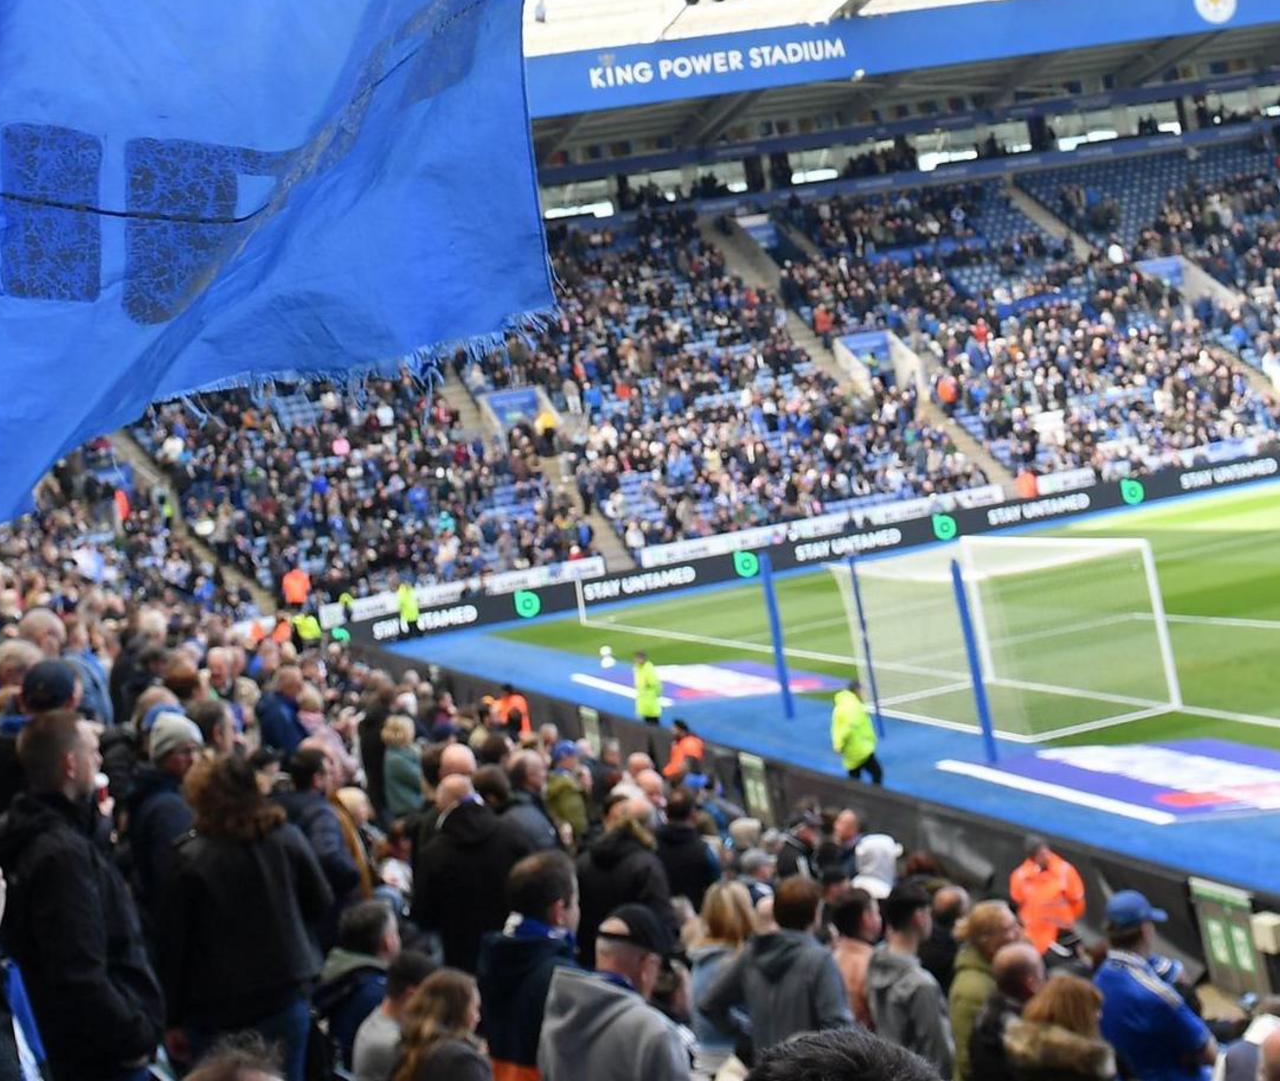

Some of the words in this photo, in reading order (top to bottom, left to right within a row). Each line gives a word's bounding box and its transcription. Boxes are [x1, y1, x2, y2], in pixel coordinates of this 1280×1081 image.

[589, 61, 654, 89] KING
[658, 50, 744, 81] POWER
[748, 38, 846, 69] STADIUM
[1180, 469, 1212, 489] STAY
[1213, 458, 1277, 483] UNTAMED
[987, 504, 1021, 525] STAY
[1022, 493, 1090, 519] UNTAMED
[795, 540, 830, 562] STAY
[831, 528, 902, 555] UNTAMED
[584, 578, 620, 601] STAY
[622, 566, 696, 594] UNTAMED
